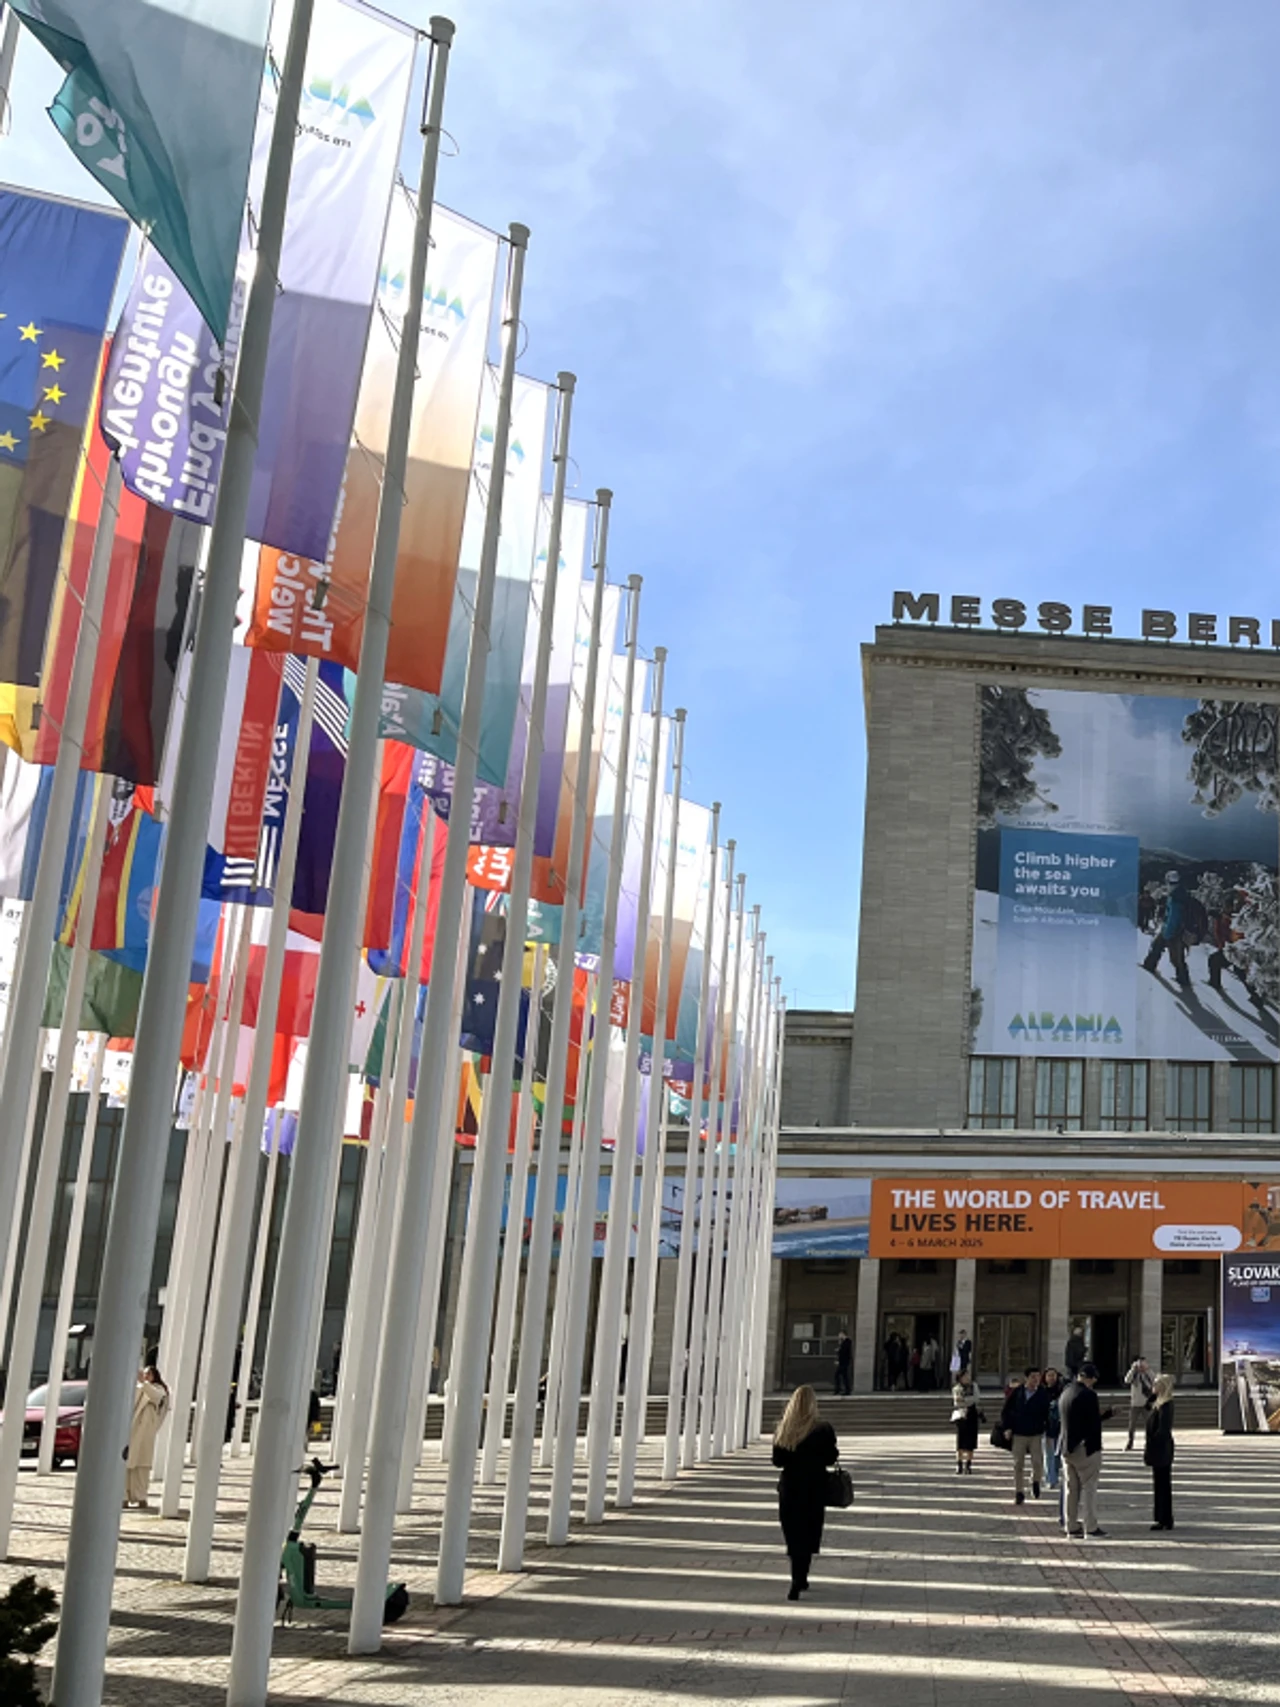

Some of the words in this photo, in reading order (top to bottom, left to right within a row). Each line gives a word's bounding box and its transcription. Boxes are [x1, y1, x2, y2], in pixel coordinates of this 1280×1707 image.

[892, 591, 1112, 635] MESSE
[1014, 851, 1062, 866] Climb
[1065, 853, 1116, 869] higher
[1014, 866, 1040, 880] the
[1045, 869, 1072, 881] sea
[1015, 882, 1067, 896] awaits
[1070, 885, 1100, 898] you
[890, 1189, 936, 1209] THE
[943, 1190, 1032, 1209] WORLD
[1039, 1190, 1071, 1209] OF
[1077, 1191, 1166, 1210] TRAVEL
[890, 1213, 957, 1232] LIVES
[965, 1214, 1034, 1232] HERE.
[917, 1239, 957, 1247] MARCH
[960, 1239, 983, 1247] 2025
